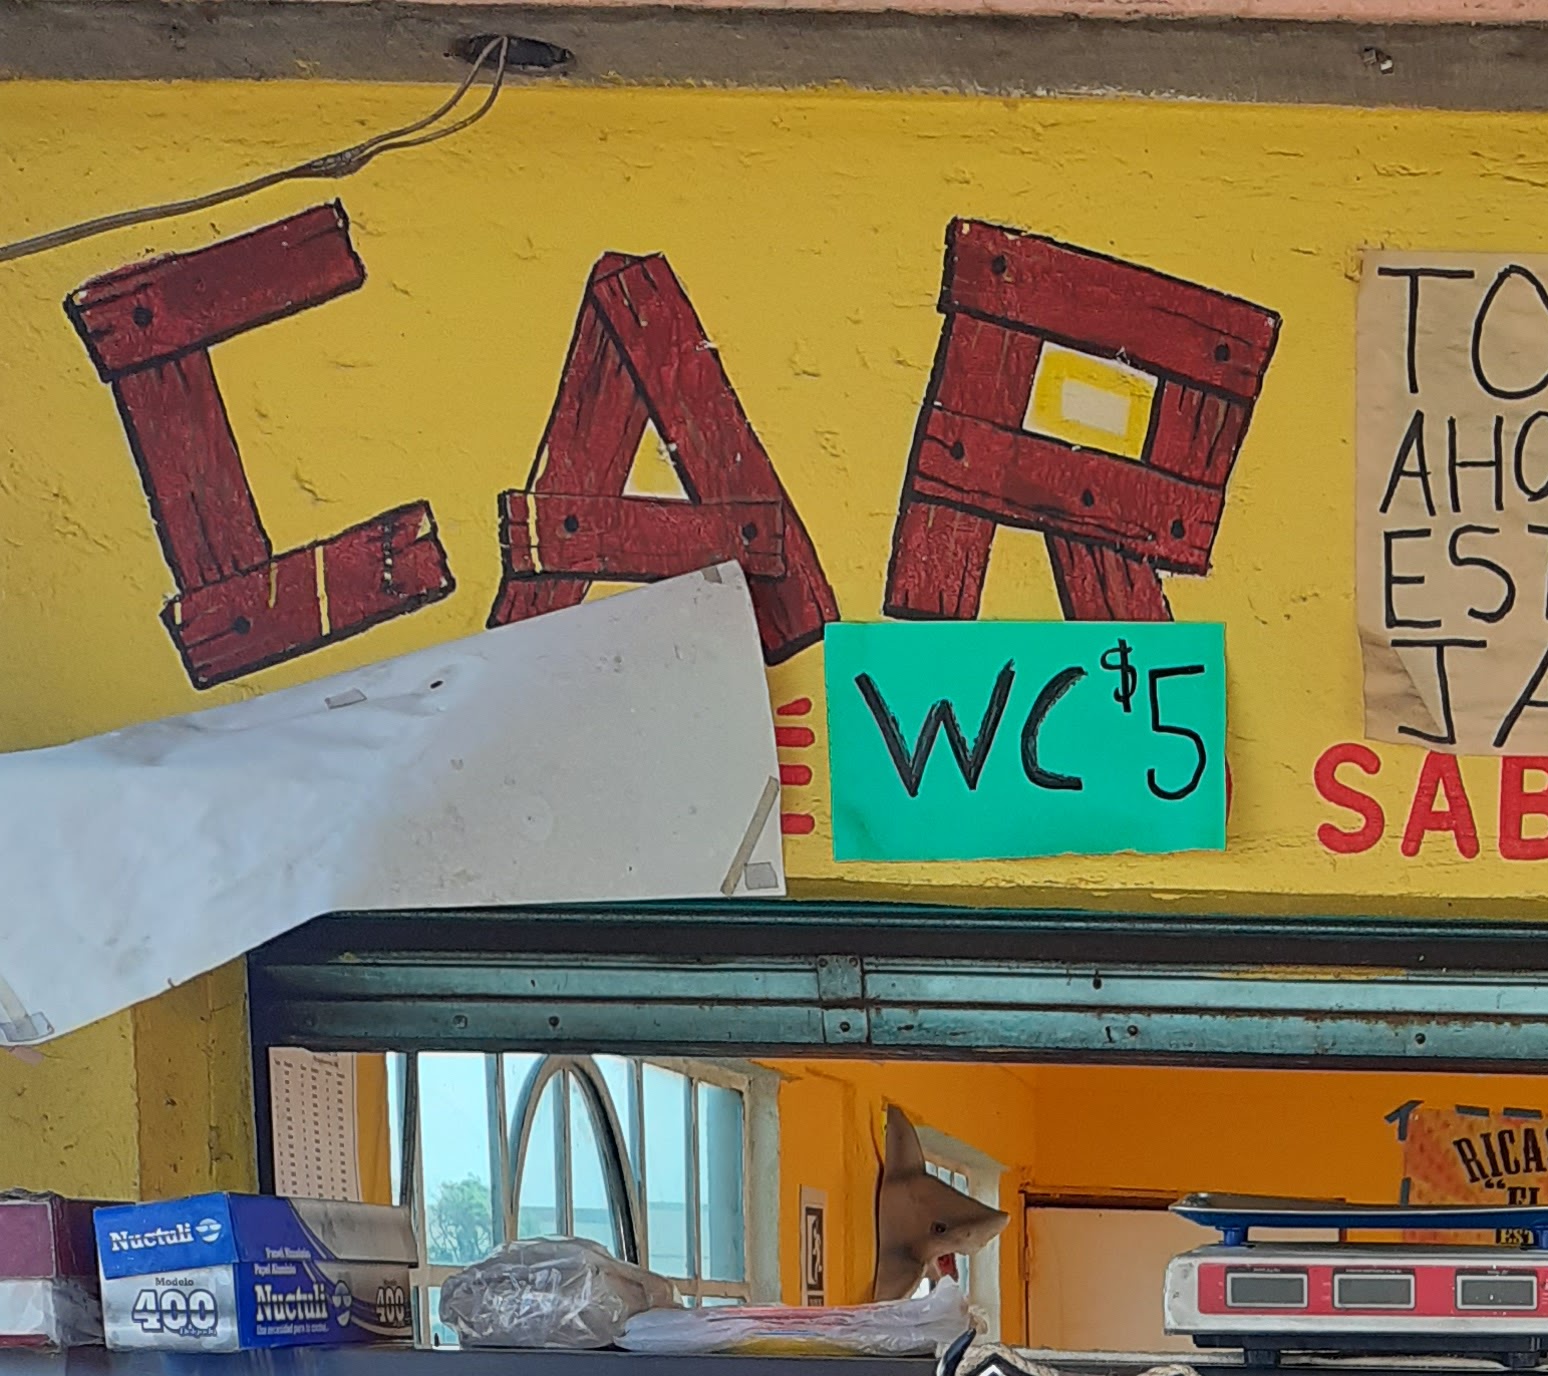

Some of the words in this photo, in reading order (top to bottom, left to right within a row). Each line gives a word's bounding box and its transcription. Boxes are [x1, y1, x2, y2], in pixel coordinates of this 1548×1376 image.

[854, 658, 1088, 798] WC
[1100, 638, 1207, 801] $5
[109, 1223, 194, 1252] Nuctuli
[155, 1277, 195, 1287] Modelo
[131, 1289, 219, 1334] 400
[254, 1283, 328, 1322] Nuctuli
[377, 1286, 405, 1324] 400
